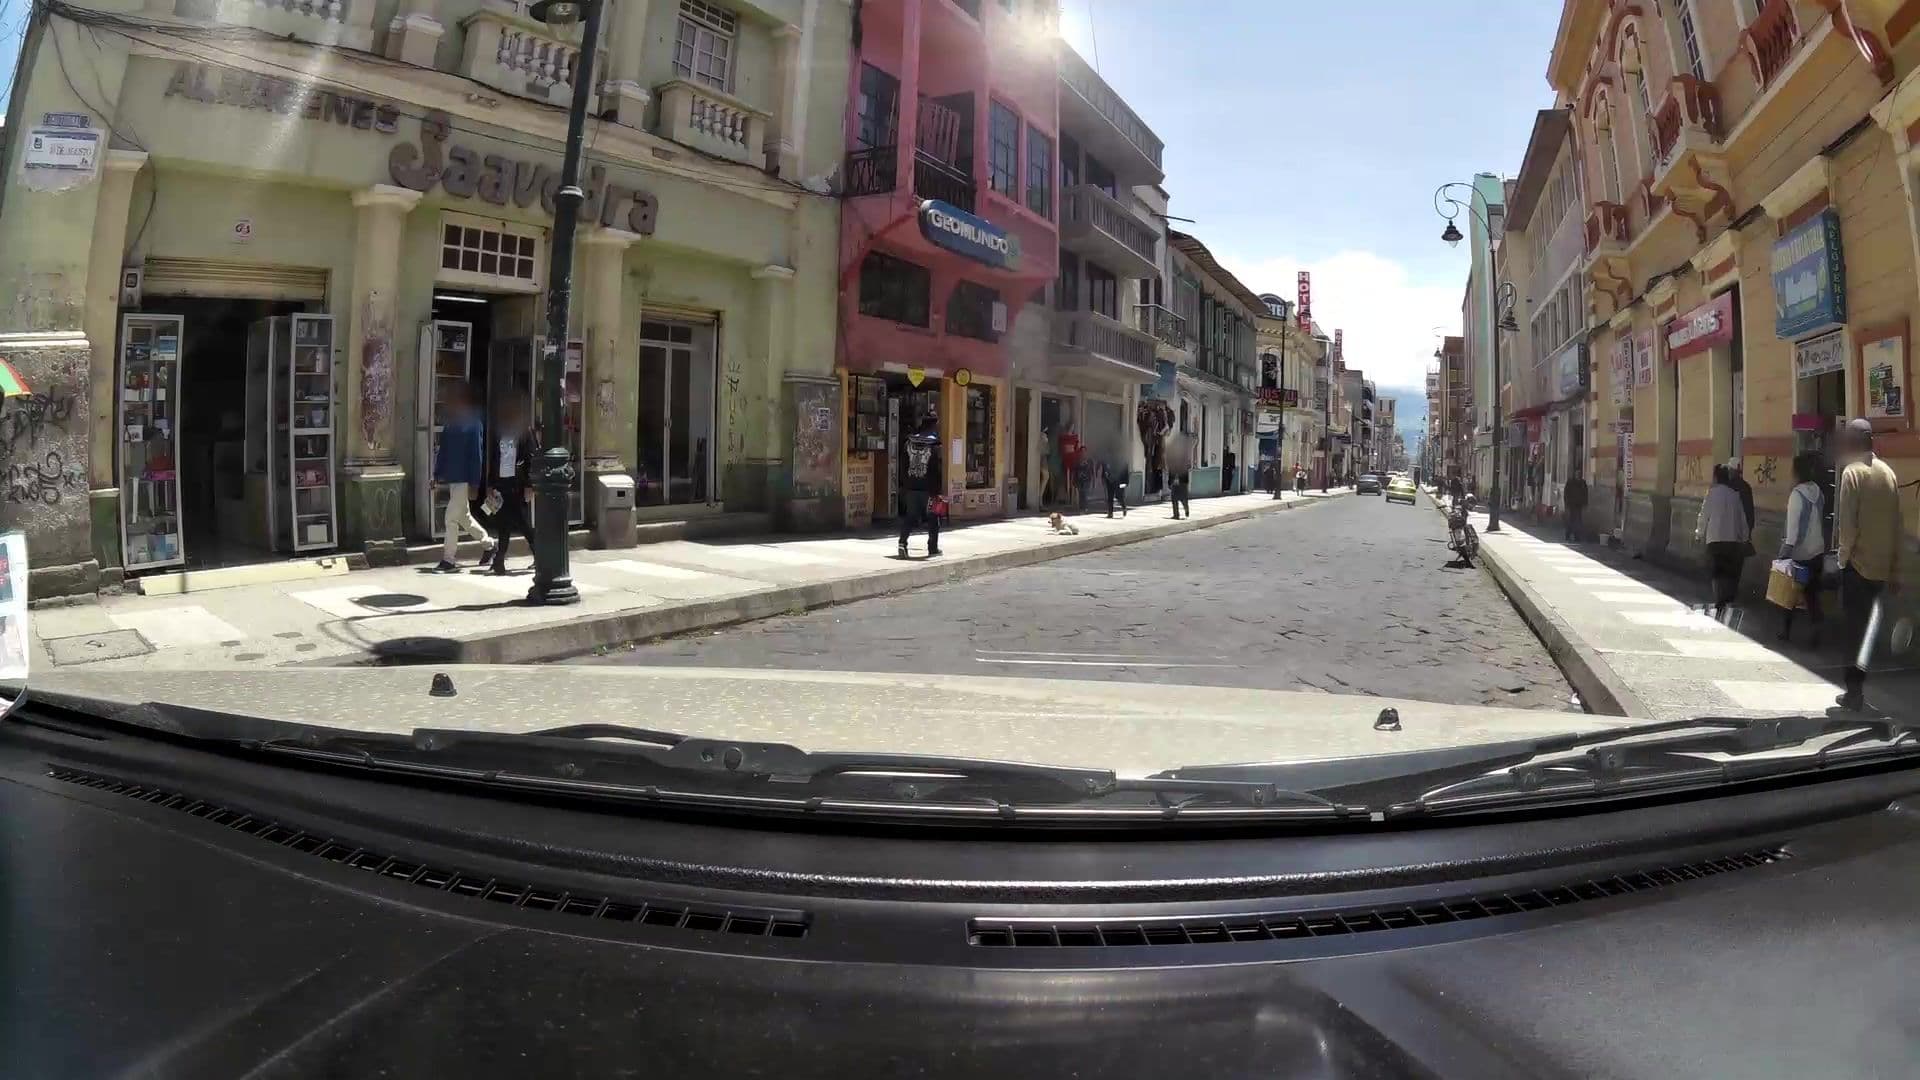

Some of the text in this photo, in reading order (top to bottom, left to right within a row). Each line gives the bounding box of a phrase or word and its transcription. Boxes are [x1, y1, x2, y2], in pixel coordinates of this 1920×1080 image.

[164, 62, 400, 134] ALENES
[928, 209, 1009, 254] GEOMUNDO
[1298, 272, 1311, 325] HOTEL
